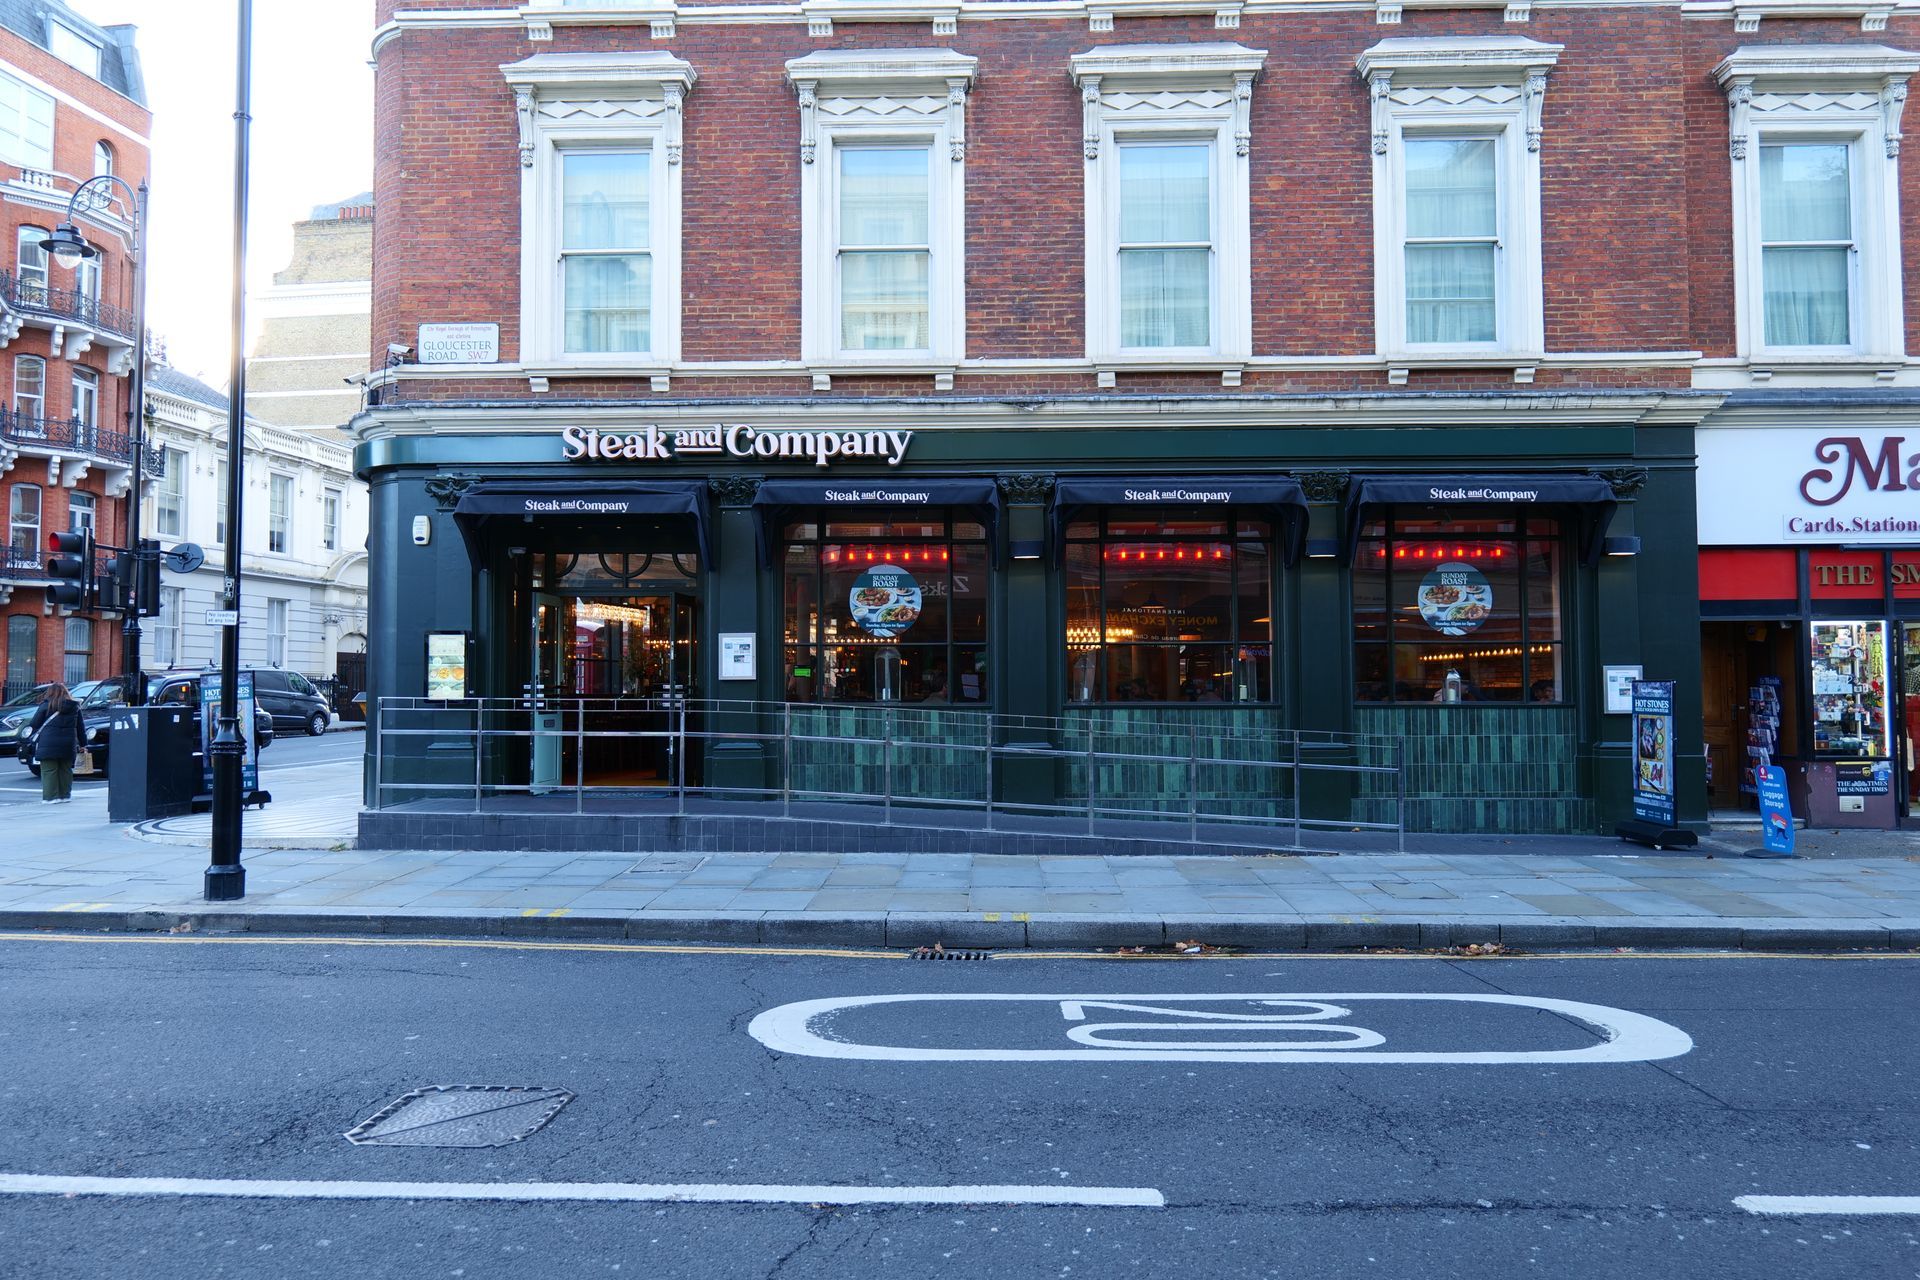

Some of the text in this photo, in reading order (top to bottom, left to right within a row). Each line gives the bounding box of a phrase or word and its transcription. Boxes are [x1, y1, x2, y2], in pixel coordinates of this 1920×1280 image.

[423, 340, 492, 350] GLOUCESTER
[562, 423, 913, 467] Steak and Company
[825, 490, 930, 503] Steak and Company
[1124, 489, 1232, 502] Steak and Company
[1430, 488, 1538, 502] Steak and Company
[525, 500, 630, 512] Steak and Company
[1816, 564, 1875, 585] THE
[1635, 698, 1669, 708] HOT STONES
[1762, 790, 1784, 800] Luggage
[1764, 798, 1784, 808] Storage
